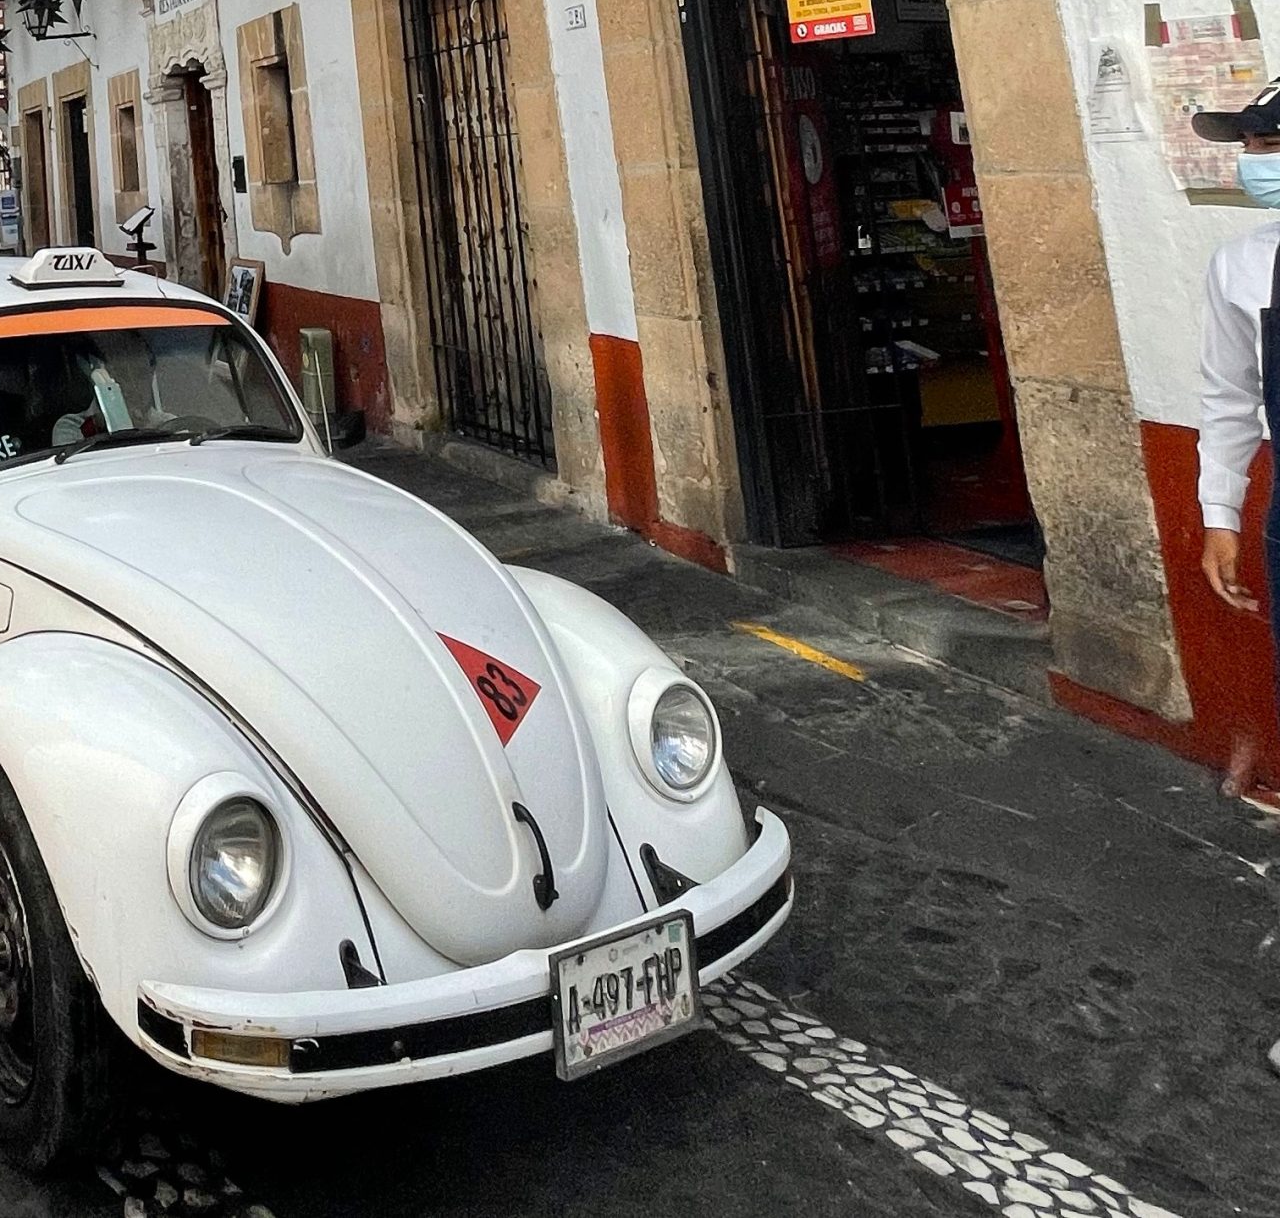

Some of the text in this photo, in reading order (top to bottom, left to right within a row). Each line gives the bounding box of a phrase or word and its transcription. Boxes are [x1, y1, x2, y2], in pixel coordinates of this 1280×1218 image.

[814, 21, 847, 36] GRACIAS
[53, 254, 95, 270] TAXI
[477, 662, 527, 721] 83
[568, 947, 682, 1036] A-497-FHP
